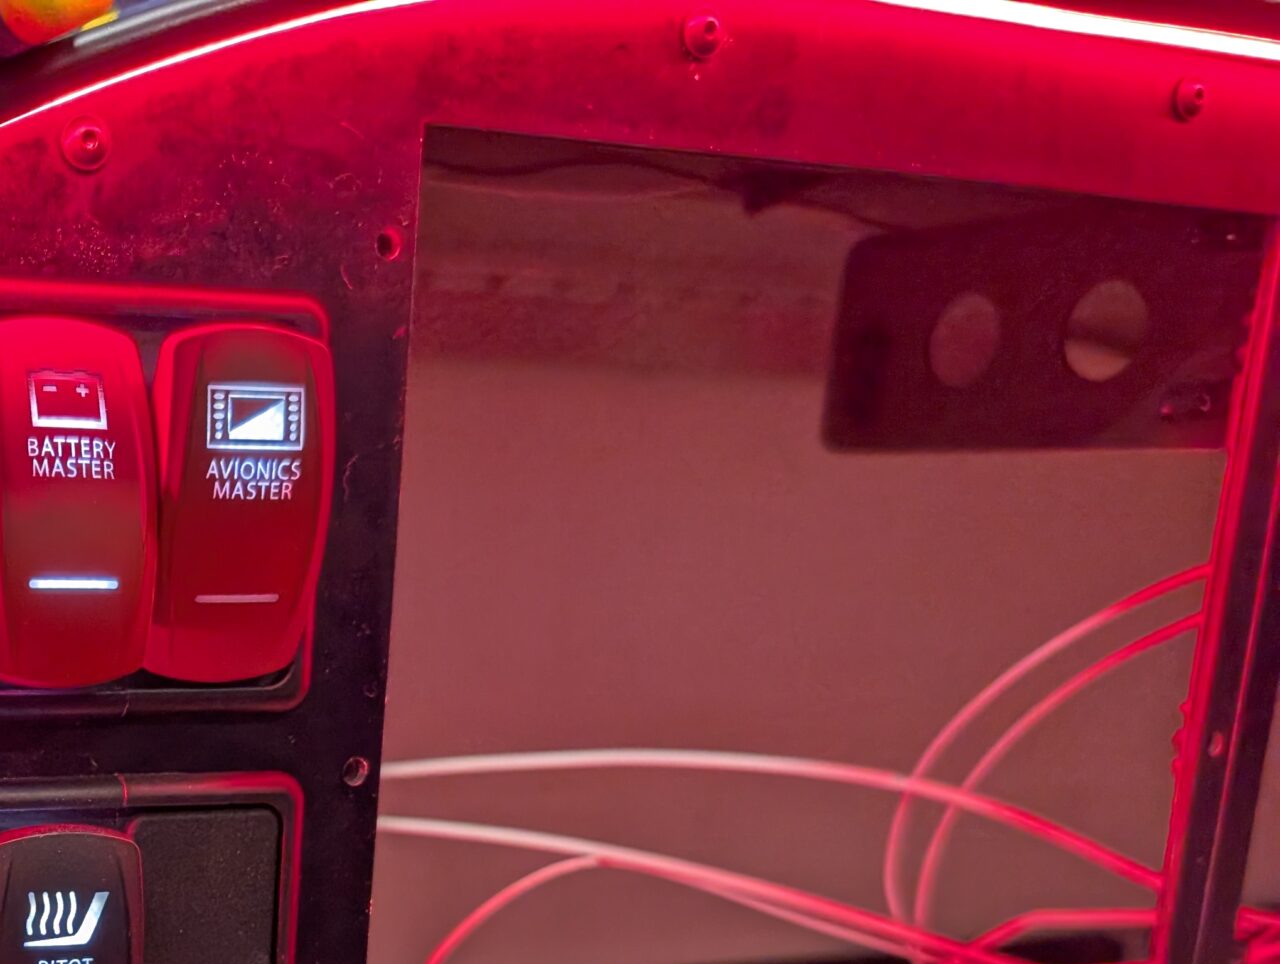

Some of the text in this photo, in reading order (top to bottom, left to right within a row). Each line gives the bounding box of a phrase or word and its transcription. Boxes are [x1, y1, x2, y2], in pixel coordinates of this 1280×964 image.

[27, 436, 116, 460] BATTERY
[32, 458, 115, 480] MASTER
[205, 457, 301, 481] AVIONICS
[212, 481, 292, 500] MASTER
